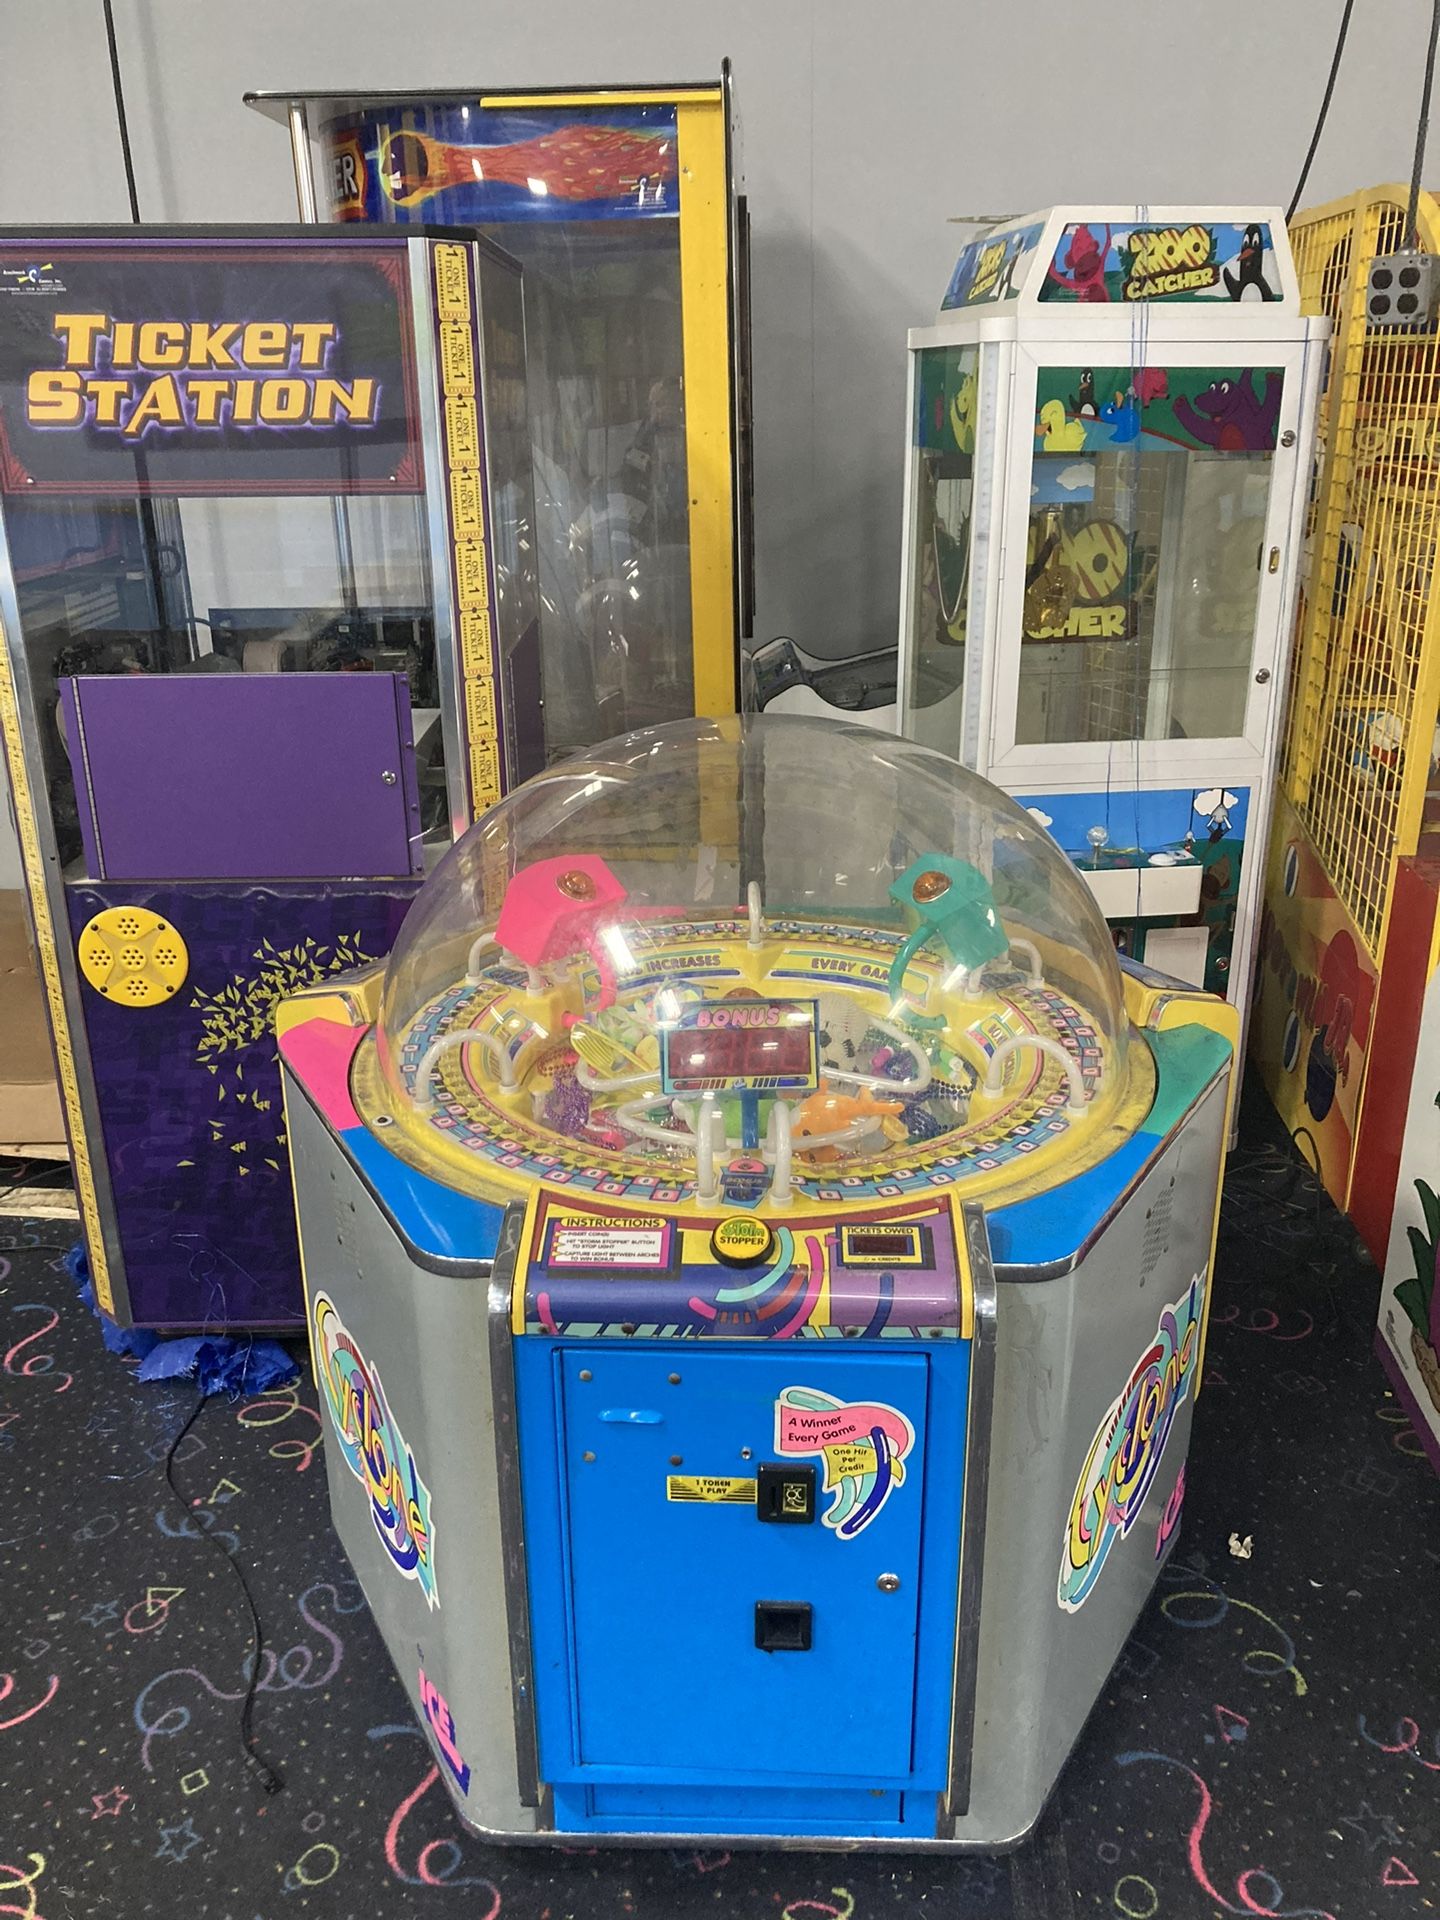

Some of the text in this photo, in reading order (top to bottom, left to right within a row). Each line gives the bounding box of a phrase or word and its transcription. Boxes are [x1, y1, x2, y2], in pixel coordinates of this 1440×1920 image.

[1129, 225, 1211, 277] ZOO
[445, 260, 454, 295] TICKET
[1126, 267, 1214, 299] CATCHER
[450, 336, 459, 371] TICKET
[26, 369, 376, 438] STATION
[455, 411, 464, 444] TICKET
[462, 417, 470, 437] ONE
[460, 484, 469, 517] TICKET
[465, 555, 473, 586] TICKET
[468, 586, 480, 594] 1
[470, 623, 478, 654] TICKET
[474, 690, 482, 720] TICKET
[479, 755, 487, 784] TICKET
[482, 783, 493, 791] 1
[645, 955, 721, 972] INCREASES
[811, 957, 891, 981] EVERY GAM
[696, 1007, 780, 1029] BONUS
[566, 1218, 661, 1228] INSTRUCTIONS
[720, 1236, 765, 1246] STOPPER
[788, 1414, 843, 1429] A Winner
[788, 1424, 858, 1445] Every Game
[832, 1448, 868, 1456] One Hit
[842, 1456, 857, 1464] Per
[838, 1463, 865, 1474] Credit
[695, 1479, 731, 1488] 1 TOKEN
[699, 1486, 728, 1494] 1 PLAY
